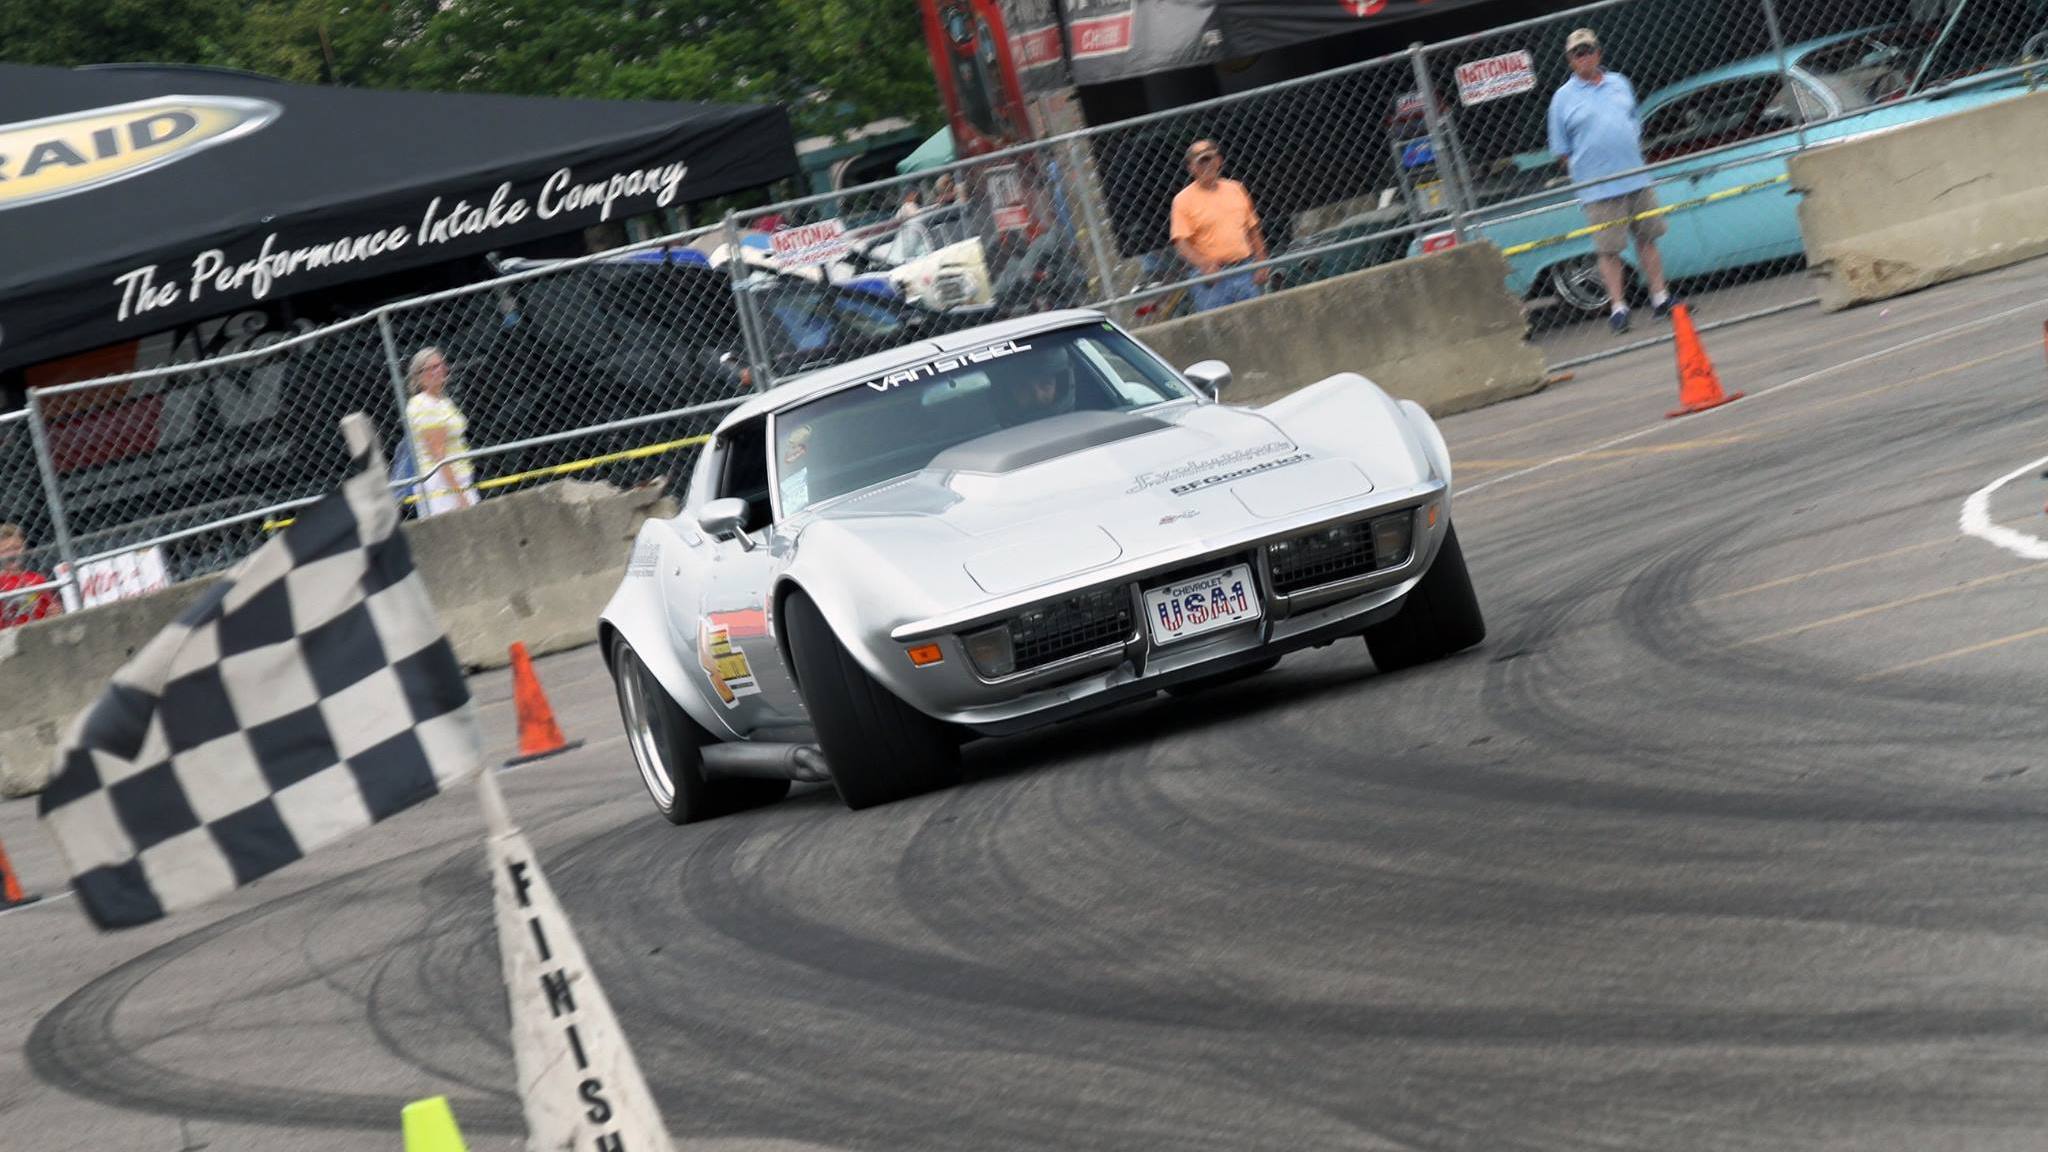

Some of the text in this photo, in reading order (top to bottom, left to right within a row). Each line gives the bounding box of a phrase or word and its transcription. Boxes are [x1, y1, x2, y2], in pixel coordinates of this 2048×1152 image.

[0, 110, 198, 181] AID
[113, 161, 688, 322] The Performance Intake Company
[1157, 580, 1248, 632] USA-1
[1172, 577, 1224, 598] CHEVROLET
